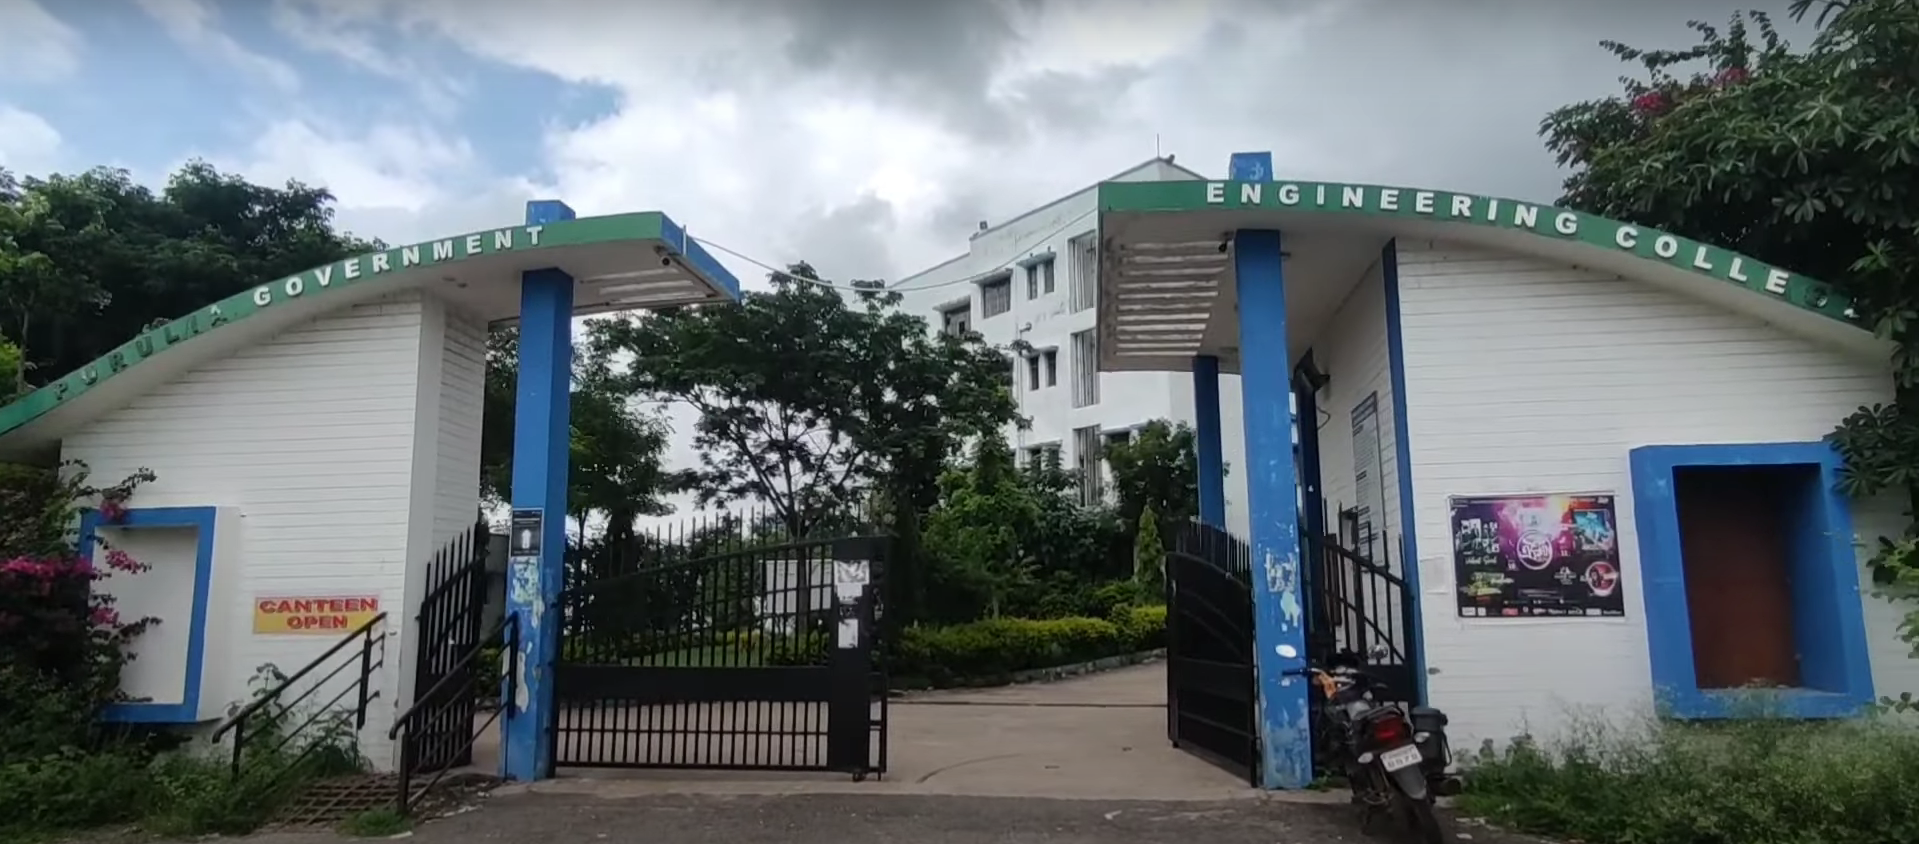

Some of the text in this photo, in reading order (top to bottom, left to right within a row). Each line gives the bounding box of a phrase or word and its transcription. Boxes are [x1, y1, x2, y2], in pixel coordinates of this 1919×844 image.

[1206, 182, 1578, 236] ENGINEERING
[253, 225, 543, 306] GOVERNMENT
[259, 598, 379, 614] CANTEEN
[286, 615, 348, 629] OPEN
